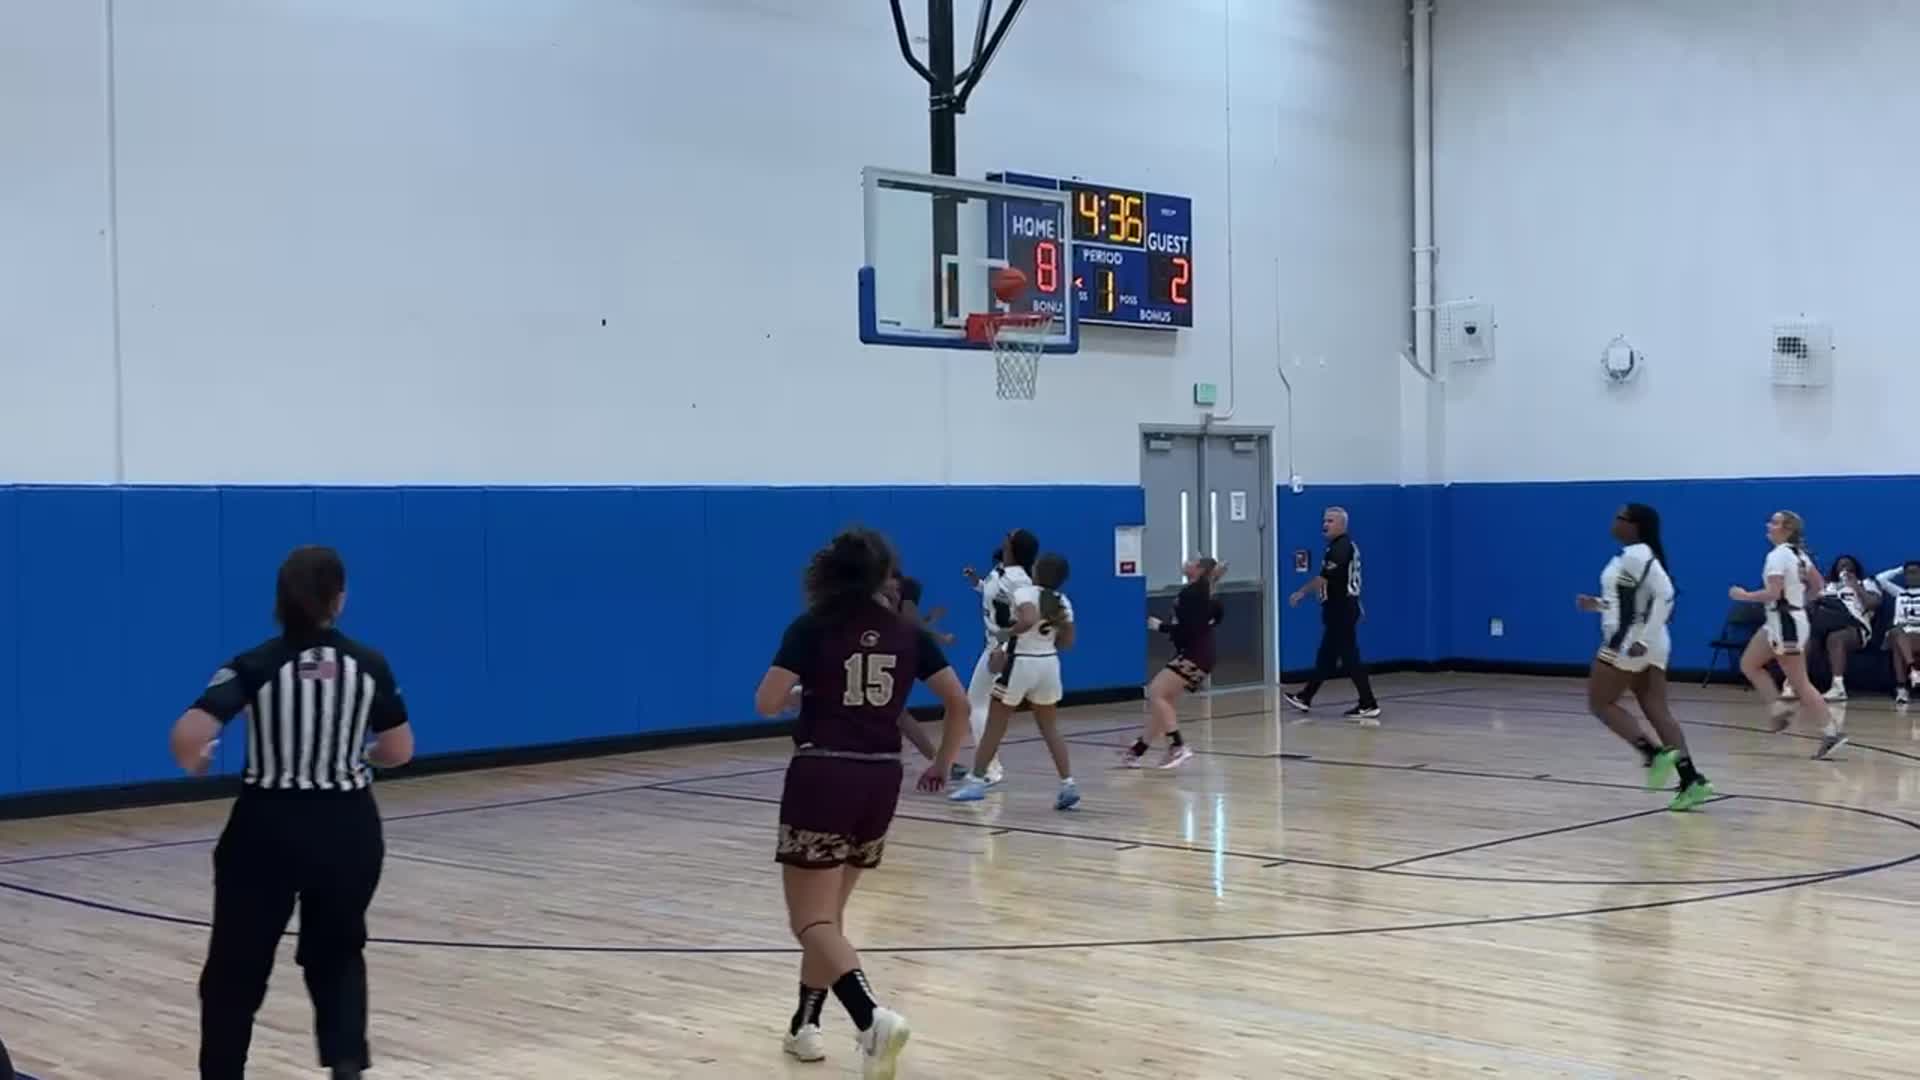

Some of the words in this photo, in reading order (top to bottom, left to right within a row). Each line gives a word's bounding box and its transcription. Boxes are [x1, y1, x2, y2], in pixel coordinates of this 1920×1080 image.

[1012, 215, 1055, 239] HOME
[1080, 193, 1142, 243] 4:36
[1082, 249, 1123, 265] PERIOD
[1148, 232, 1188, 254] GUEST
[1037, 242, 1056, 292] 8
[1171, 258, 1189, 304] 2
[1033, 300, 1063, 313] BONU
[1107, 271, 1113, 312] 1
[1139, 308, 1172, 322] BONUS
[843, 652, 897, 706] 15
